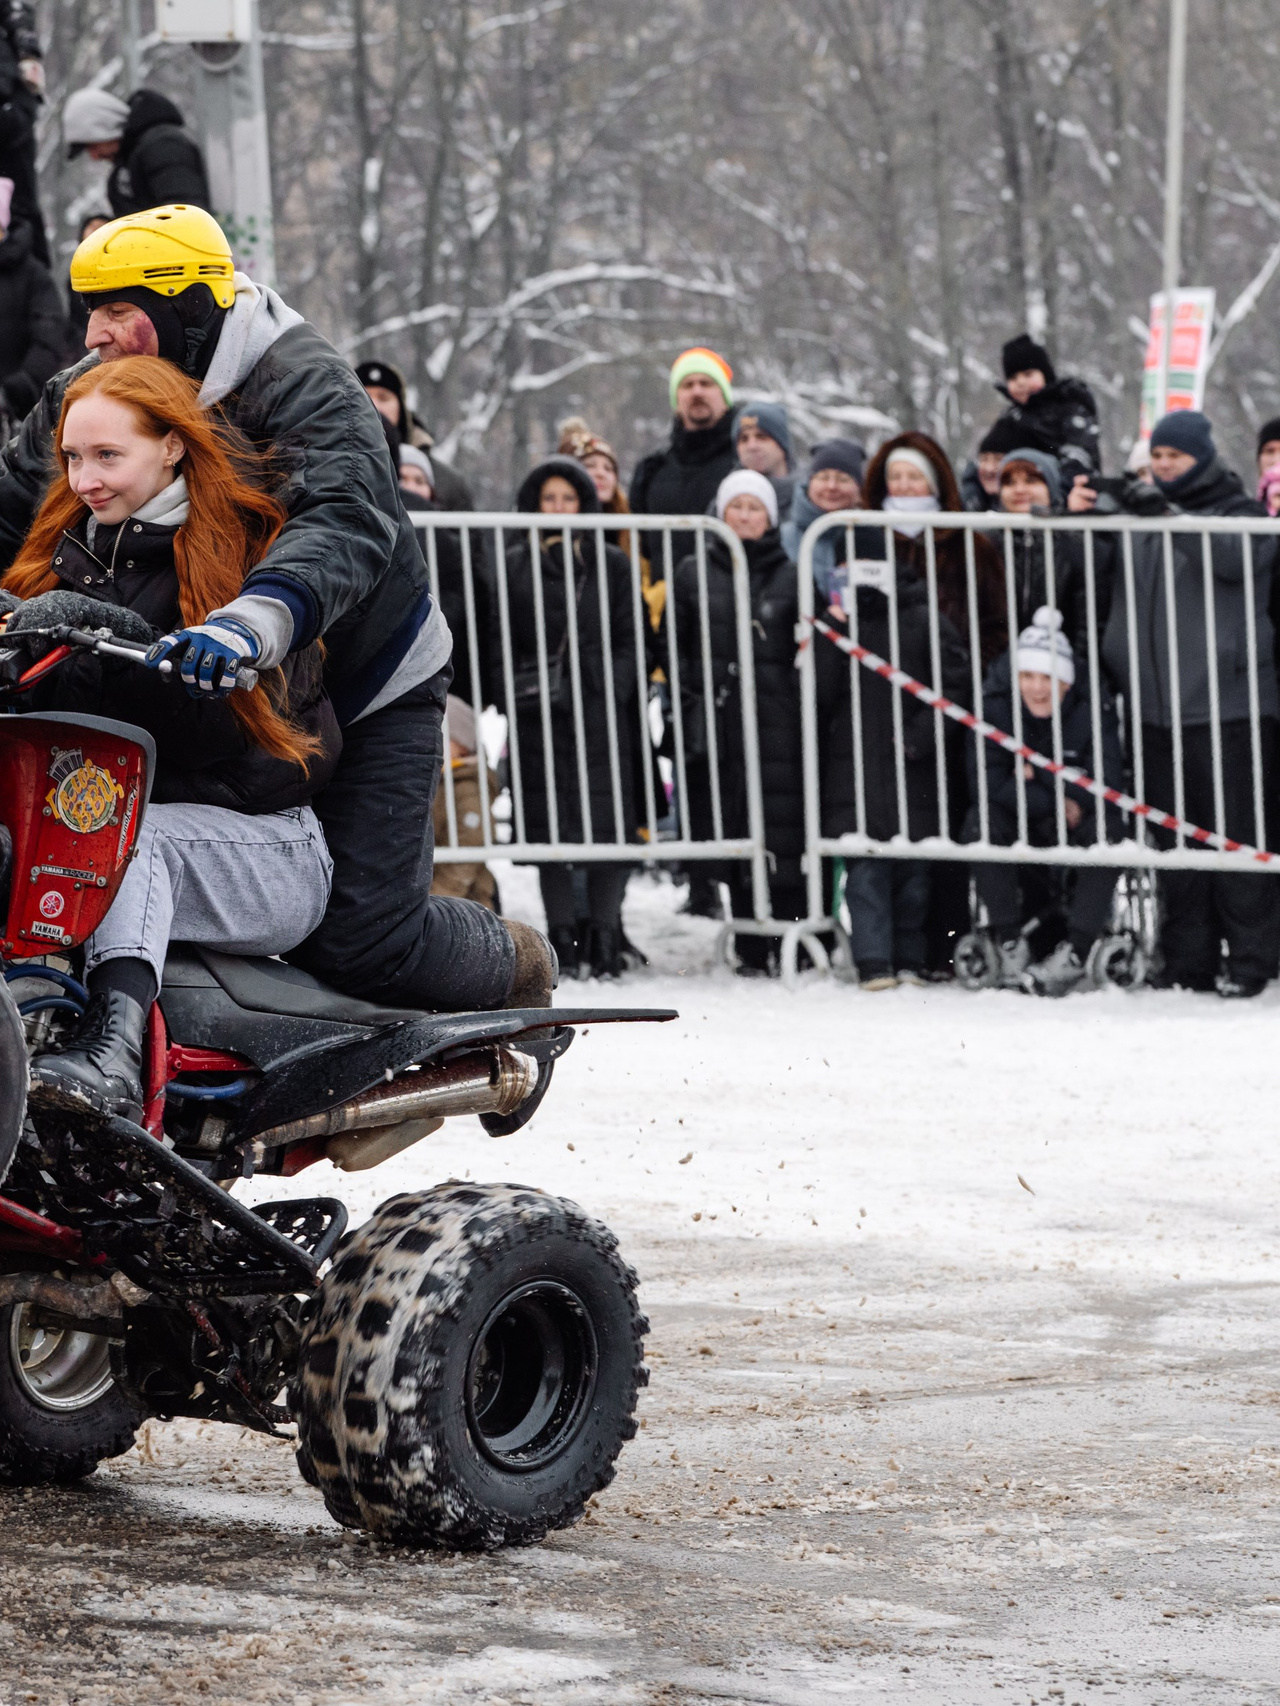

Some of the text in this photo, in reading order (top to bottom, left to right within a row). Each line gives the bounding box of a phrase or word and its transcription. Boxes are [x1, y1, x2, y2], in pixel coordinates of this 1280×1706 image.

[41, 865, 93, 880] YAMAHA RACING
[34, 924, 61, 936] YAMAHA
